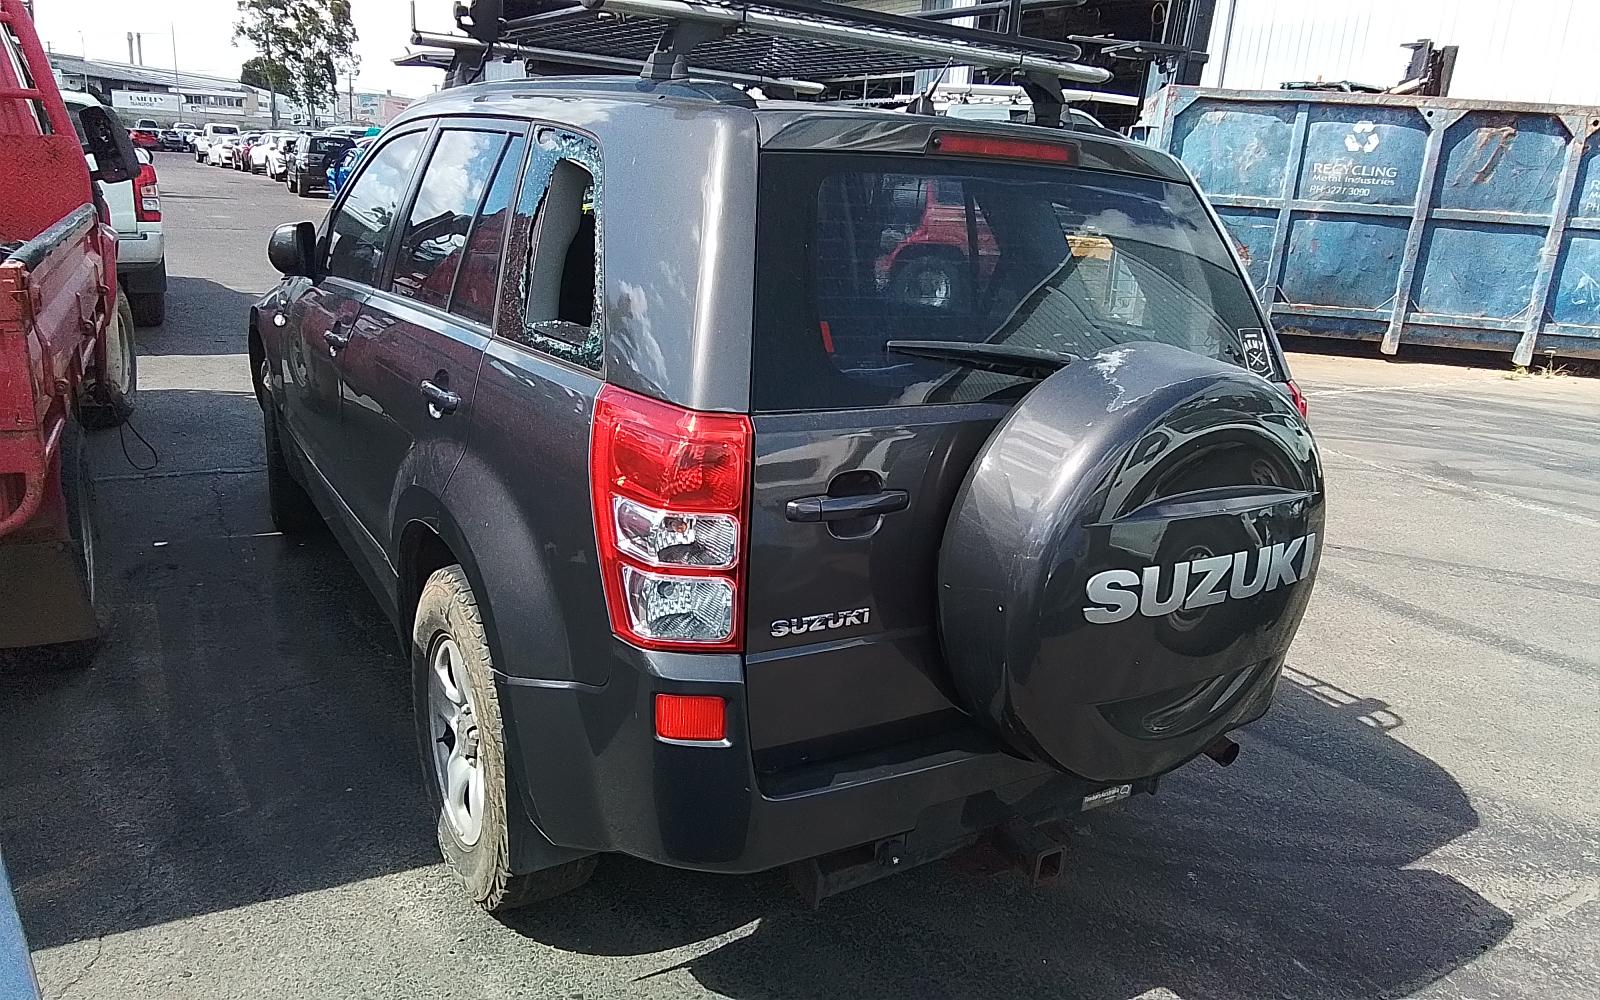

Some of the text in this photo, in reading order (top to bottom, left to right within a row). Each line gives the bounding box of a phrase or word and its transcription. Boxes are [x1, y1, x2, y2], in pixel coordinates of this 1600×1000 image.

[1313, 163, 1398, 178] RECYCLING
[1312, 174, 1395, 186] Metal Industries
[1243, 339, 1264, 352] ARMY
[1082, 533, 1316, 625] SUZUKI
[770, 607, 870, 637] SUZUKI
